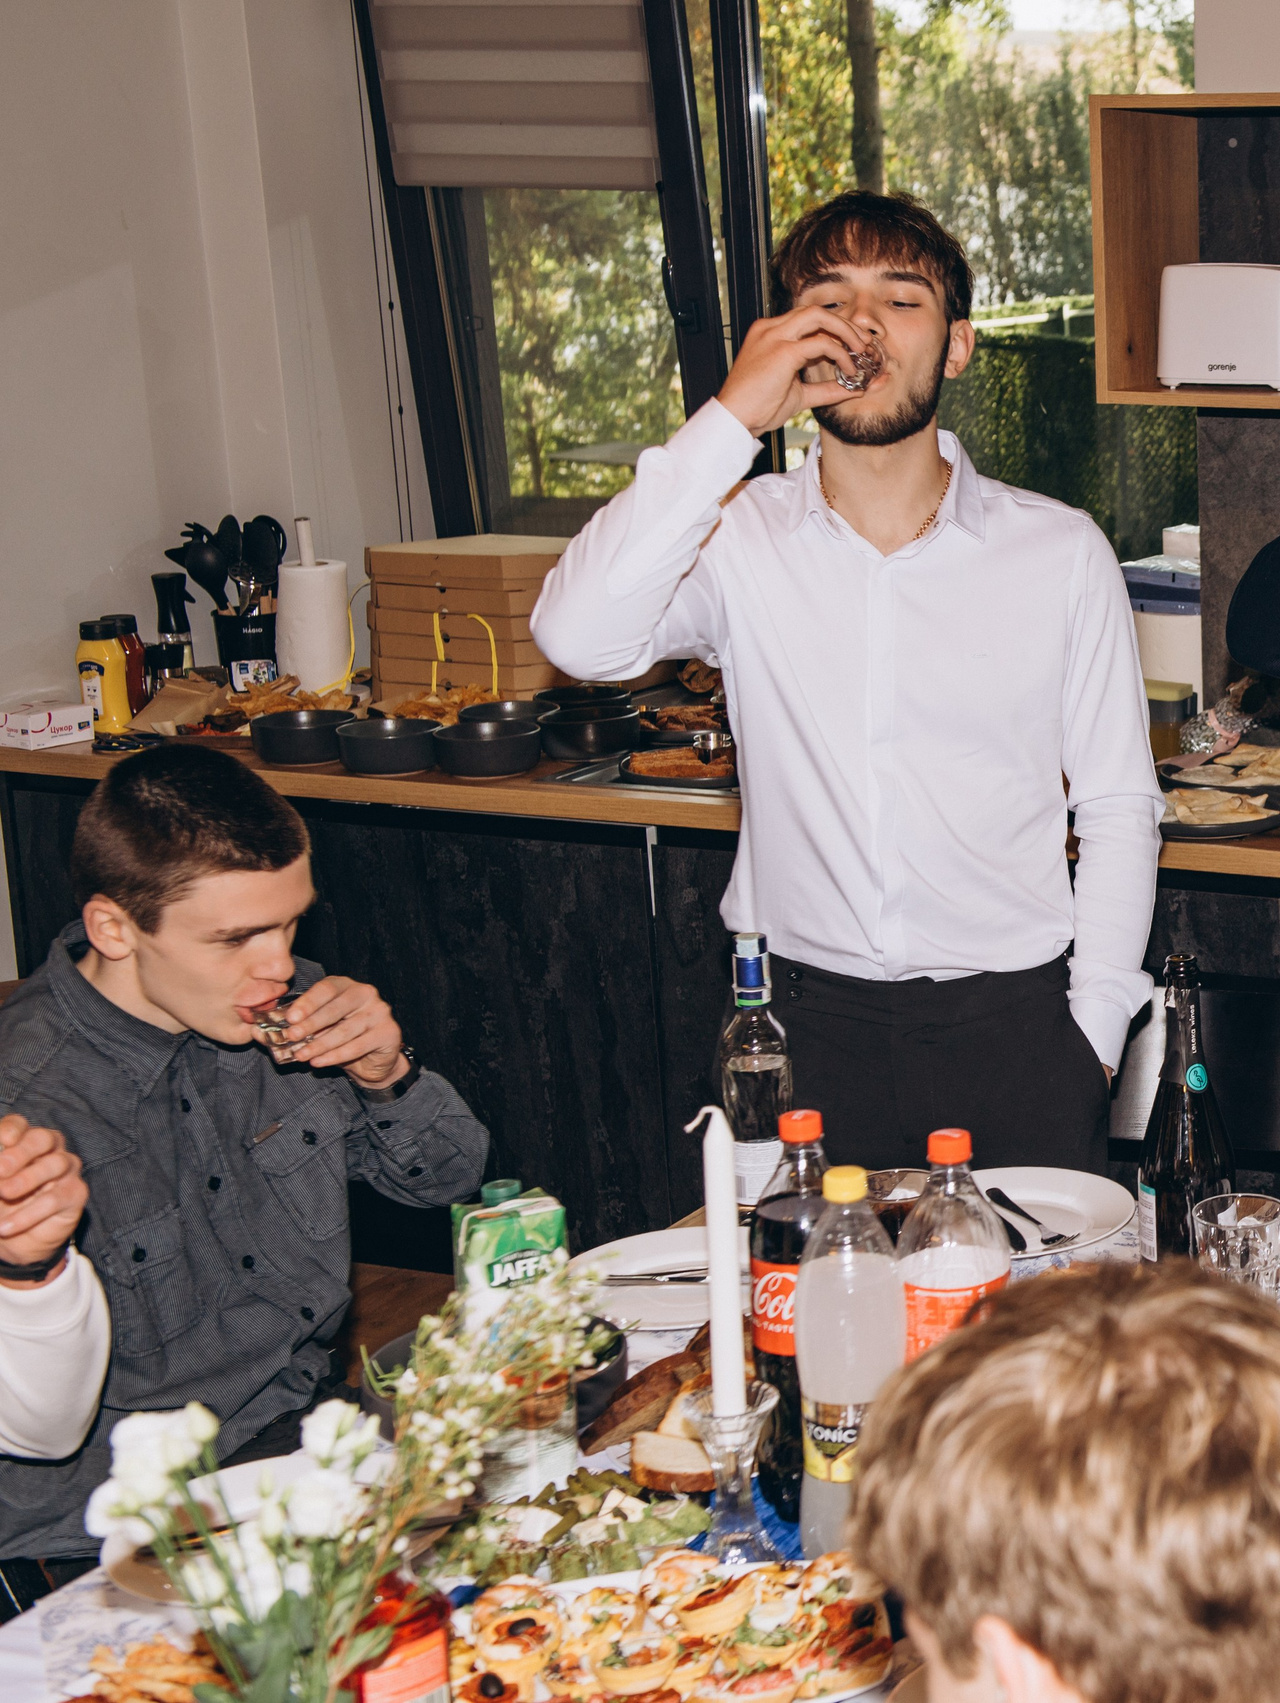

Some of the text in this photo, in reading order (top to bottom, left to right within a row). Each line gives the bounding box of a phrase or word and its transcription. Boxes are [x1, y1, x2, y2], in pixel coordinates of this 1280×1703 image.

[1208, 362, 1237, 372] gorenje
[50, 725, 73, 735] Цукор
[753, 1271, 798, 1321] Col
[806, 1422, 858, 1444] TONIC
